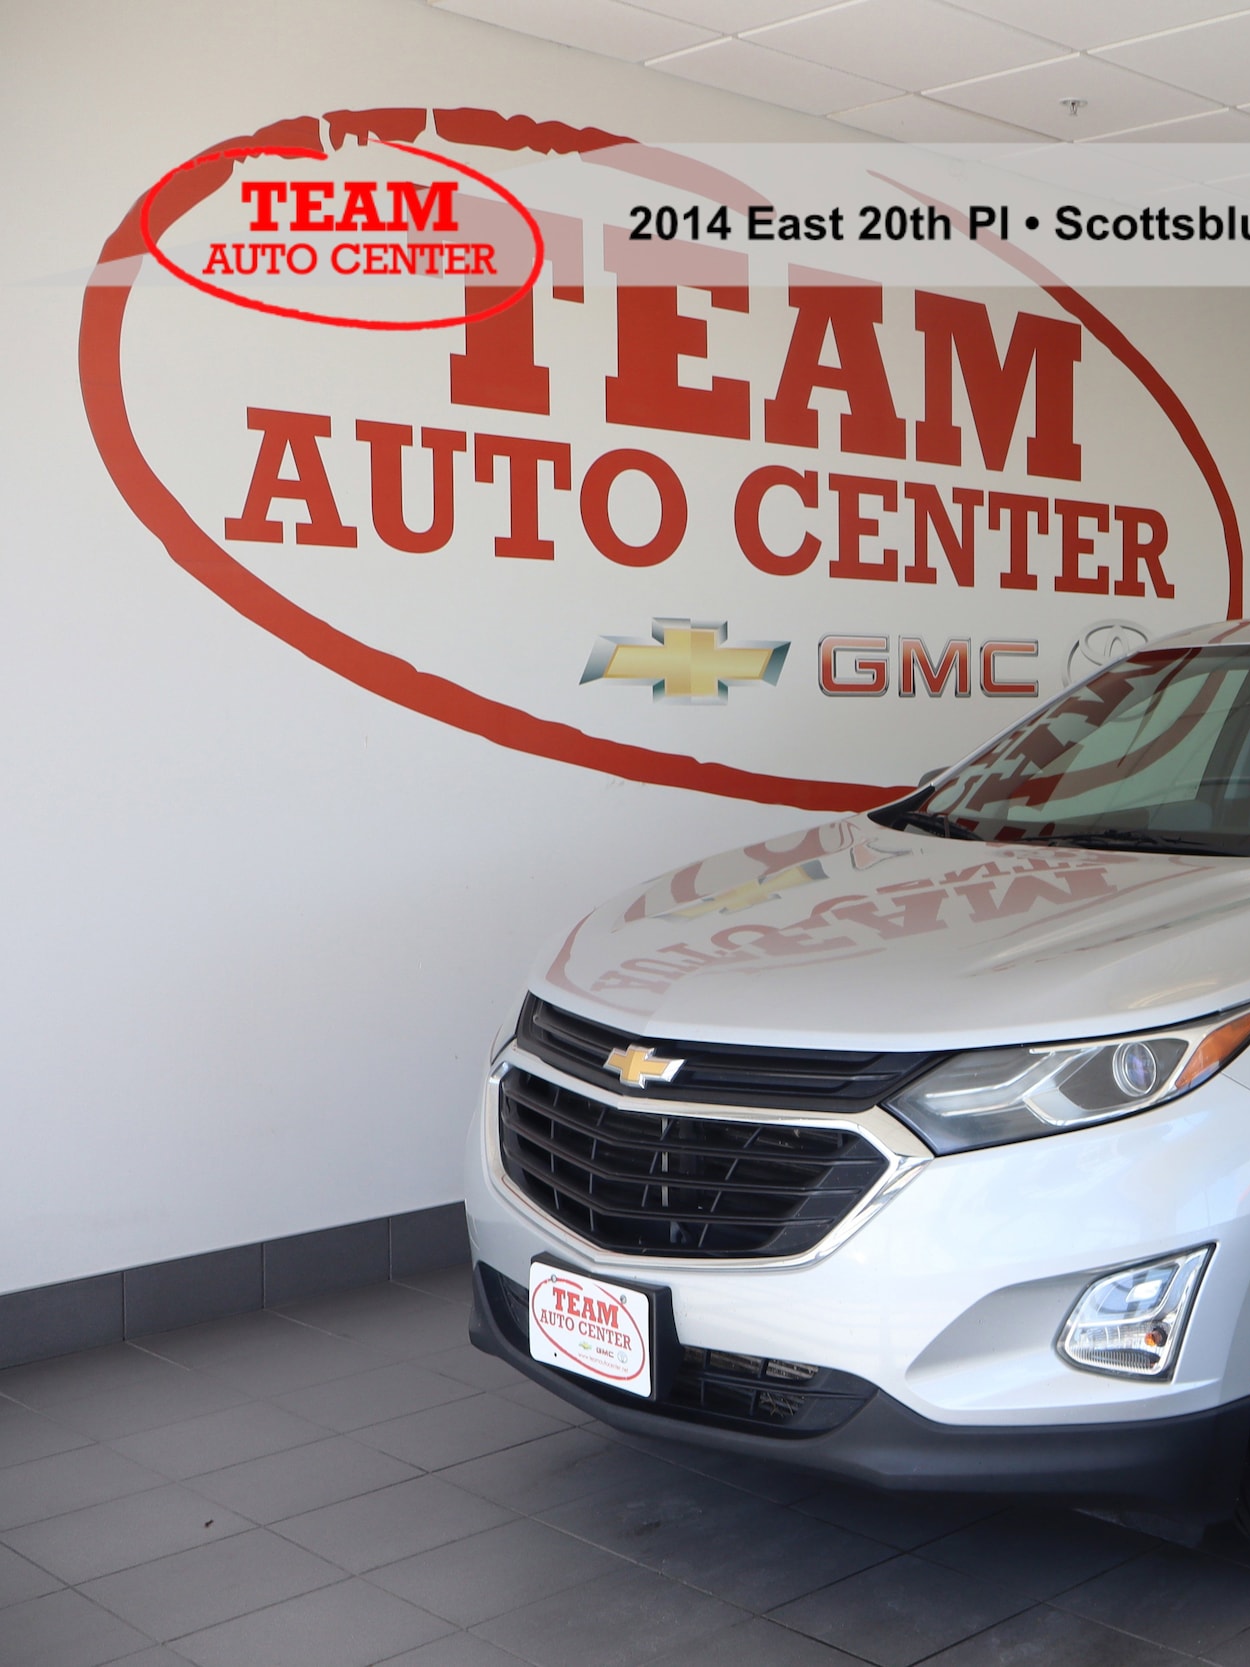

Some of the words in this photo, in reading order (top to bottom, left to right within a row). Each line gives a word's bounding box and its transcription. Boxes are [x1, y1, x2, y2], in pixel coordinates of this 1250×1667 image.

[407, 183, 1082, 482] TEAM
[225, 407, 688, 567] AUTO
[734, 464, 1175, 599] CENTER
[818, 633, 1039, 698] GMC
[540, 1308, 575, 1332] AUTO
[578, 1320, 632, 1351] CENTER
[552, 1287, 619, 1329] TEAM
[595, 1346, 615, 1359] GMC
